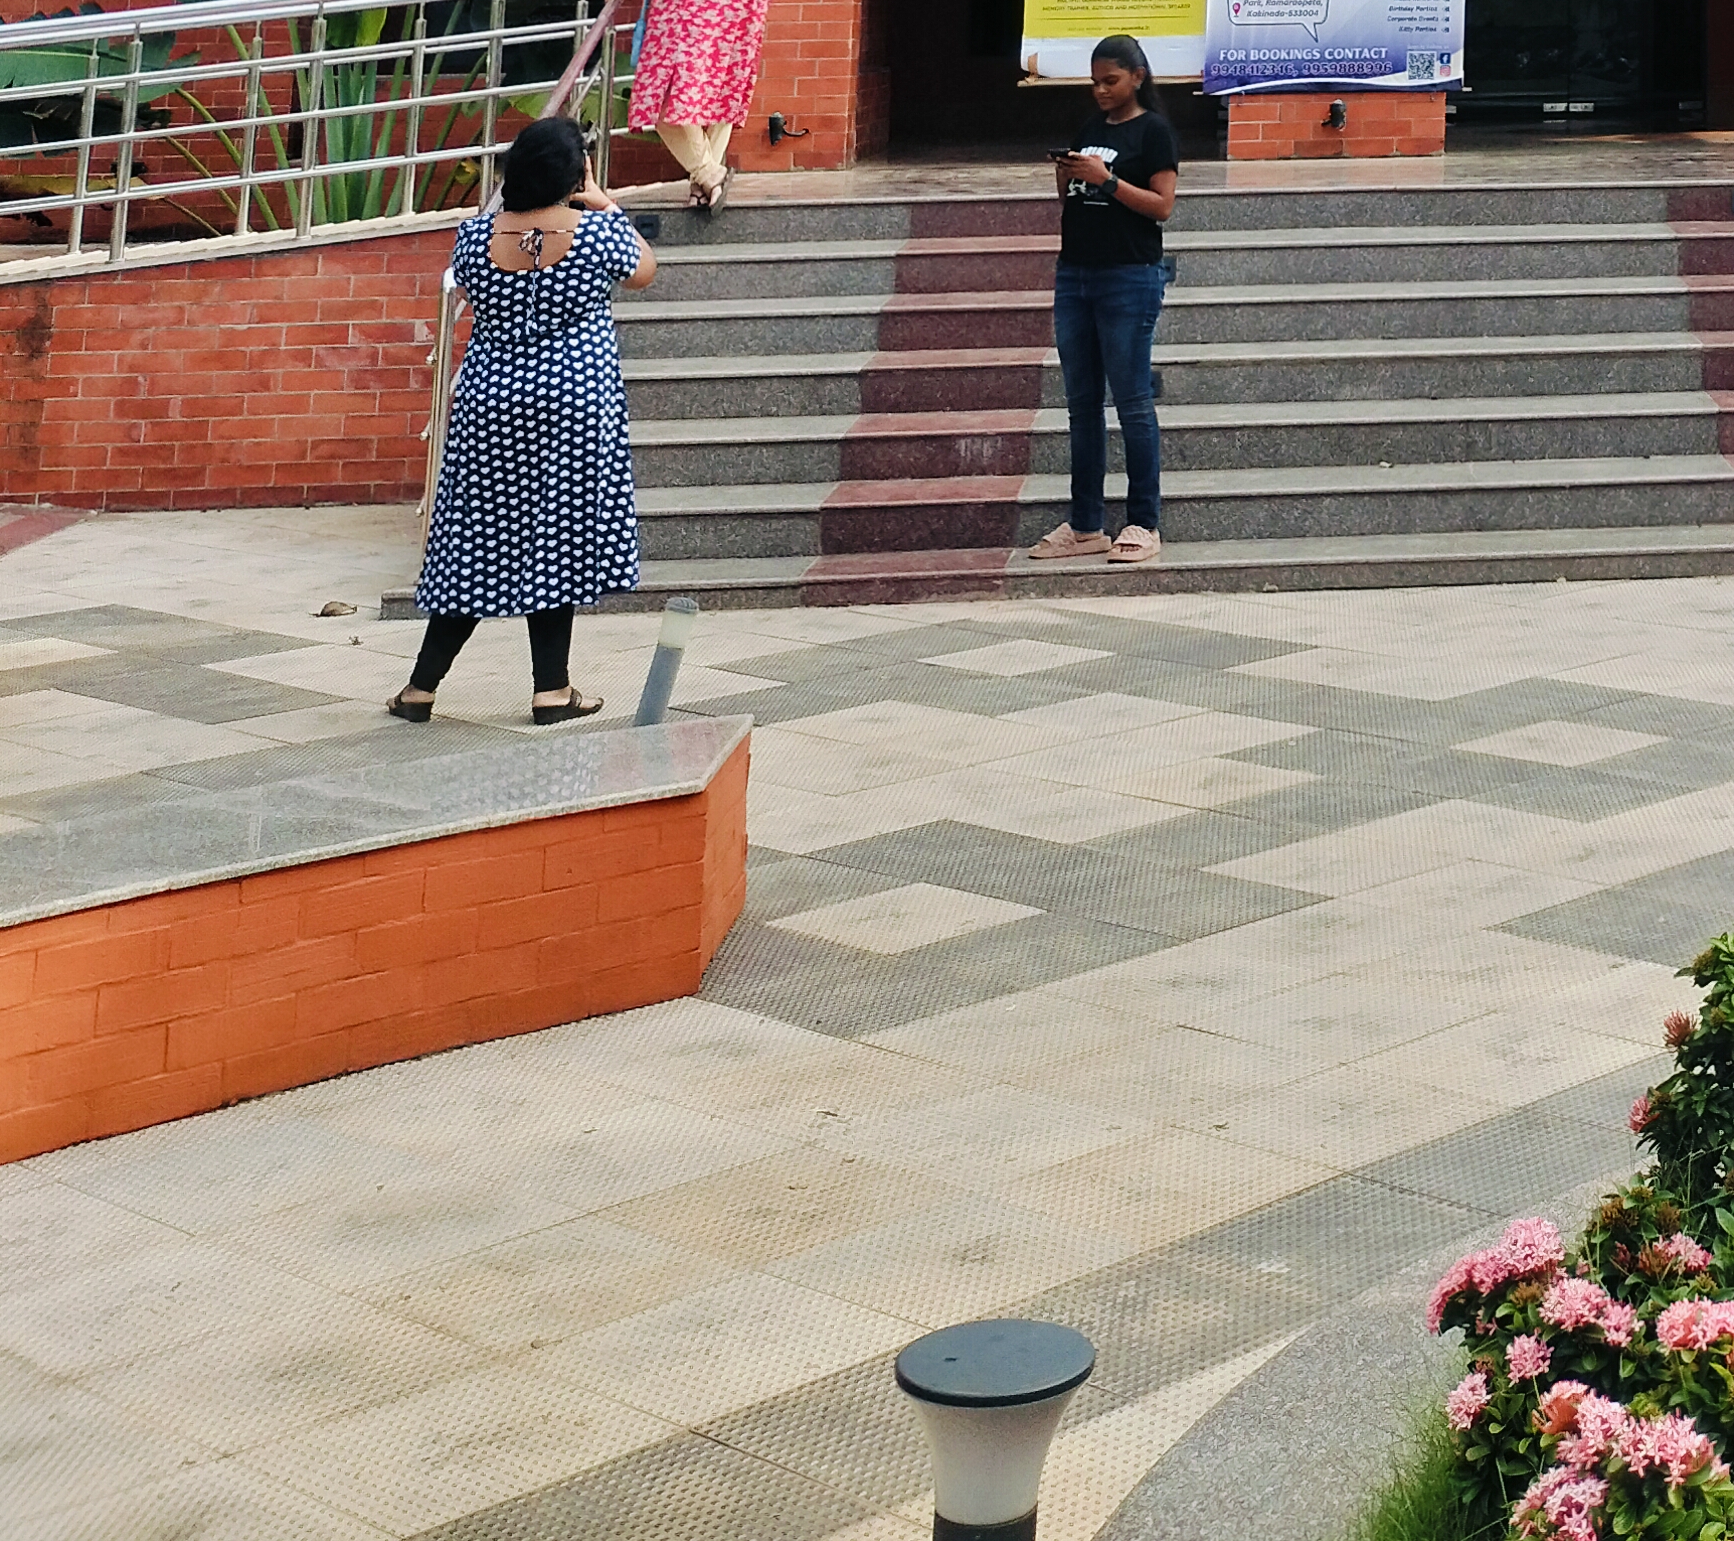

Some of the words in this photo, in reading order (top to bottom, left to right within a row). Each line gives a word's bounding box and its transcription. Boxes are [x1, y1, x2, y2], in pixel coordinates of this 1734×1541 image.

[1219, 50, 1246, 61] FOR
[1250, 48, 1321, 60] BOOKINGS
[1324, 48, 1388, 59] CONTACT
[1302, 61, 1393, 75] 9959888996
